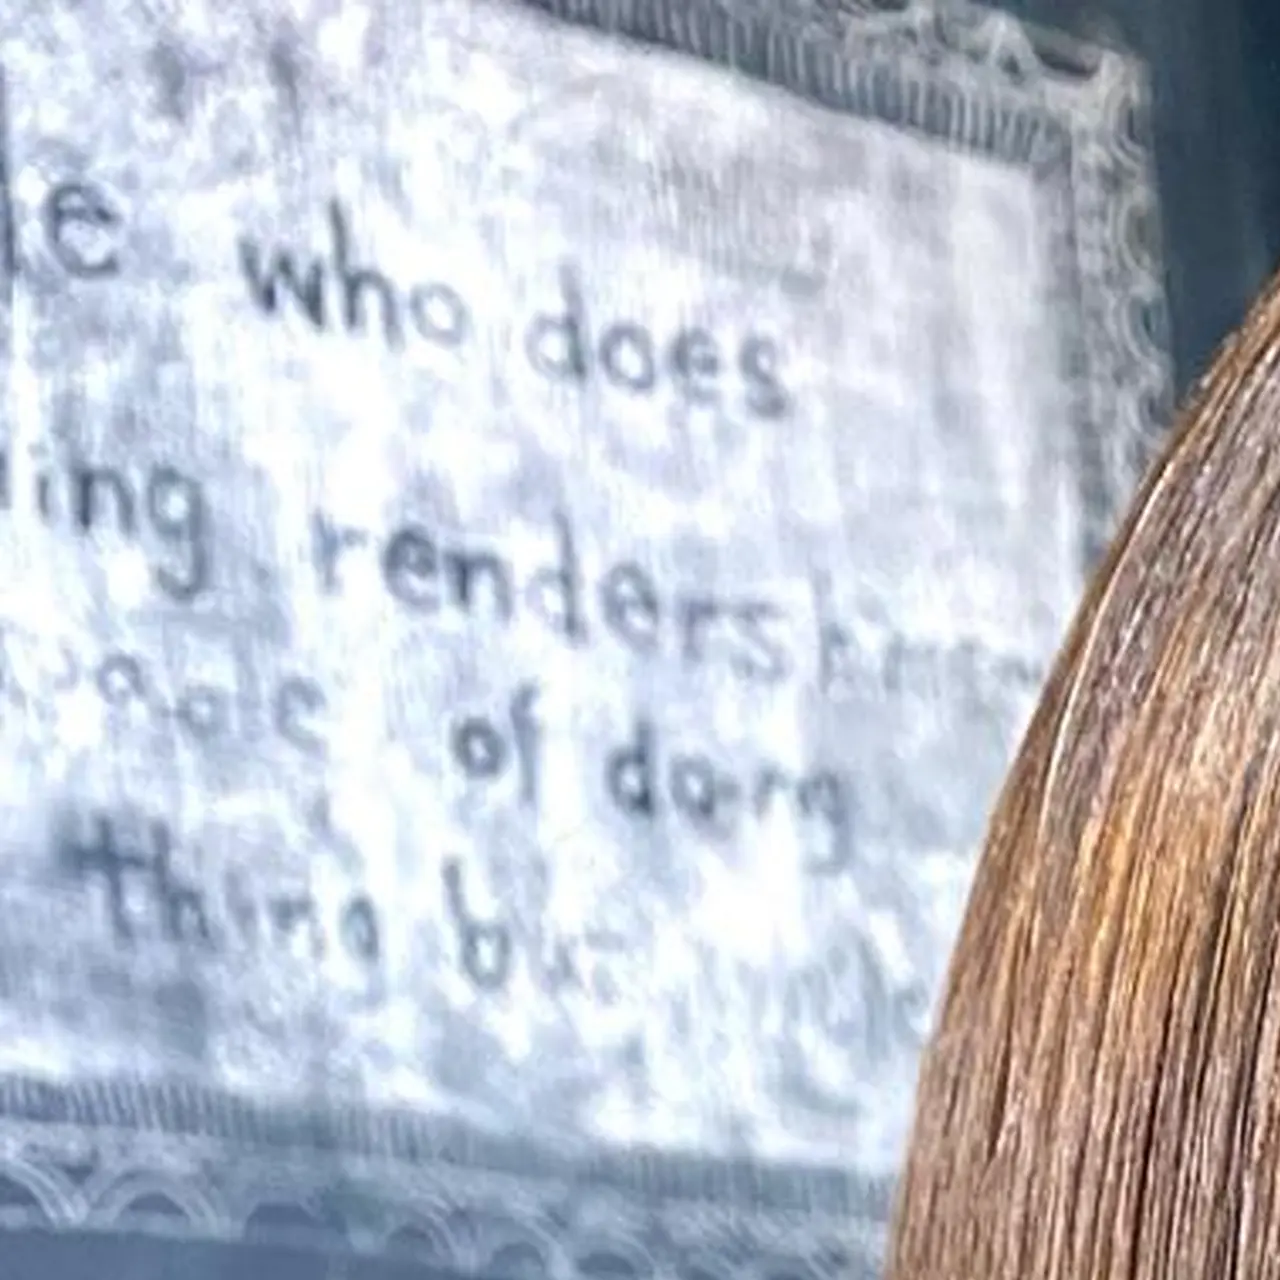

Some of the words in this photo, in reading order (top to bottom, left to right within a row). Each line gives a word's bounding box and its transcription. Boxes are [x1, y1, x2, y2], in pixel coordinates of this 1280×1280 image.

[236, 196, 470, 350] who
[525, 256, 790, 419] does
[0, 440, 210, 602] ing
[312, 504, 787, 686] renders
[451, 678, 541, 803] of
